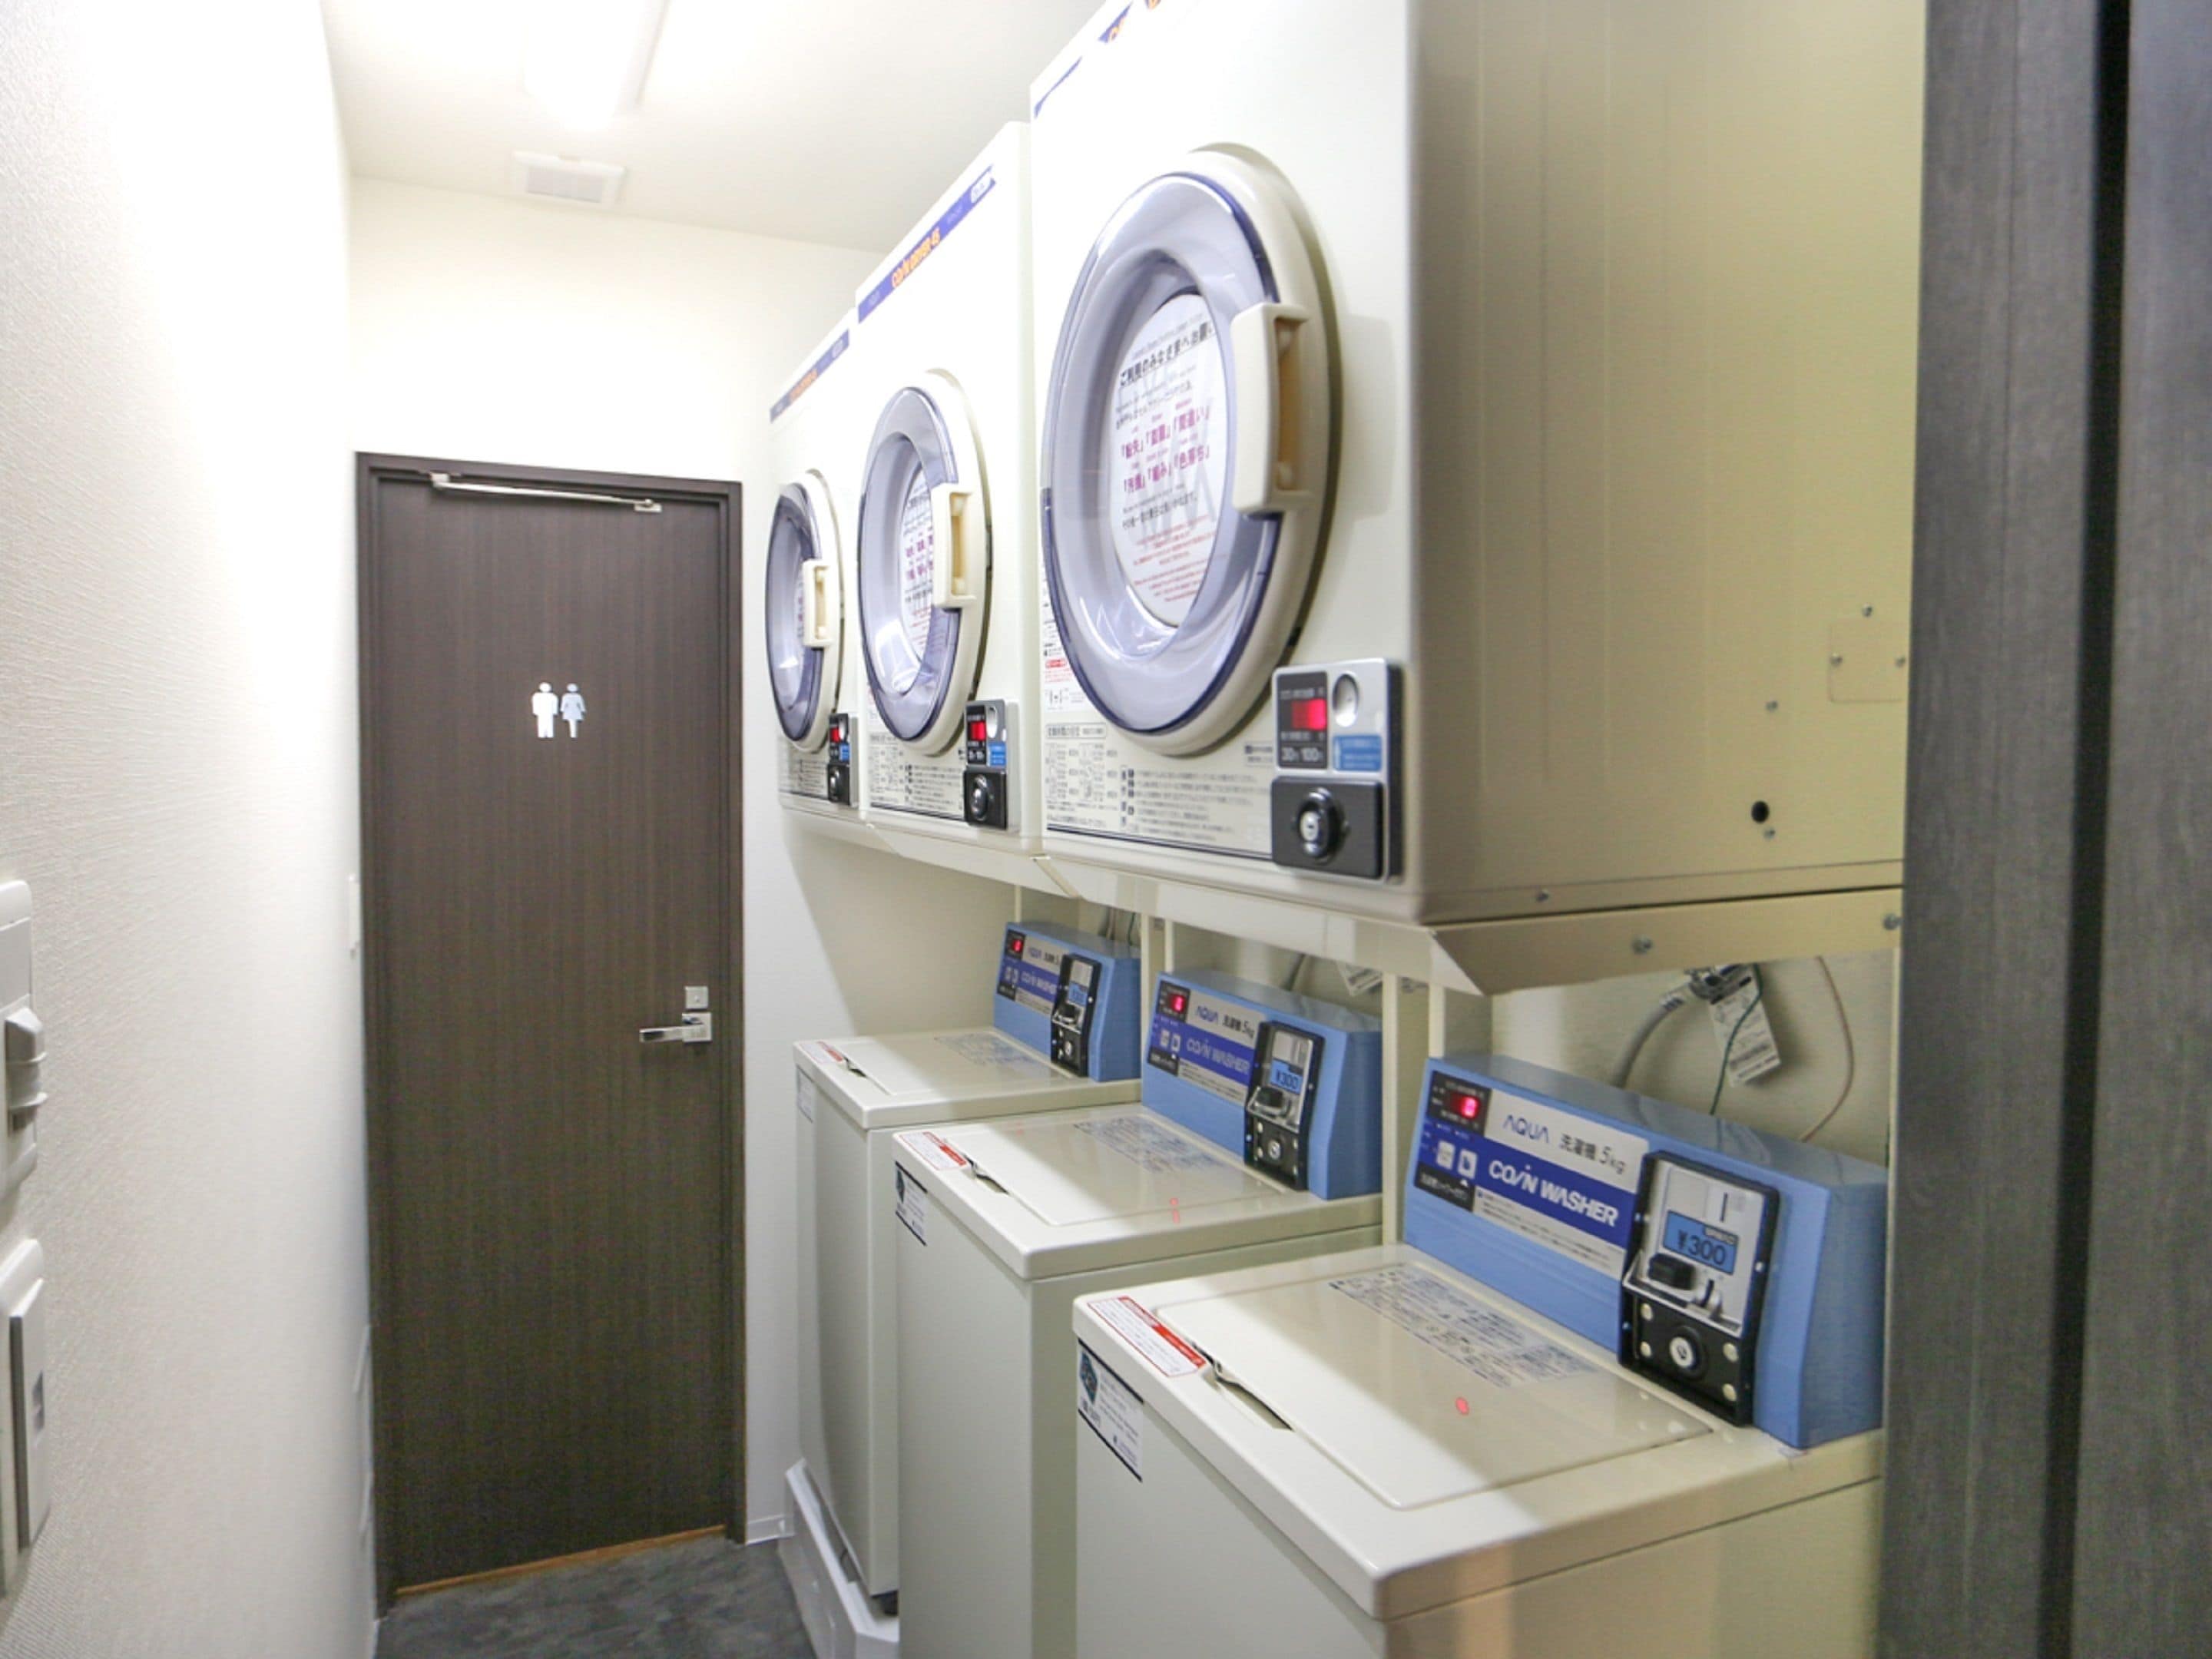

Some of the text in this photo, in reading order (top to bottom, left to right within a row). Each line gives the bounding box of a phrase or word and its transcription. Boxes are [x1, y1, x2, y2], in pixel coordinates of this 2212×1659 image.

[1502, 1114, 1550, 1144] AQUA
[1598, 1145, 1627, 1176] 5kg
[1539, 1179, 1620, 1227] WASHER
[1677, 1229, 1727, 1266] ¥300
